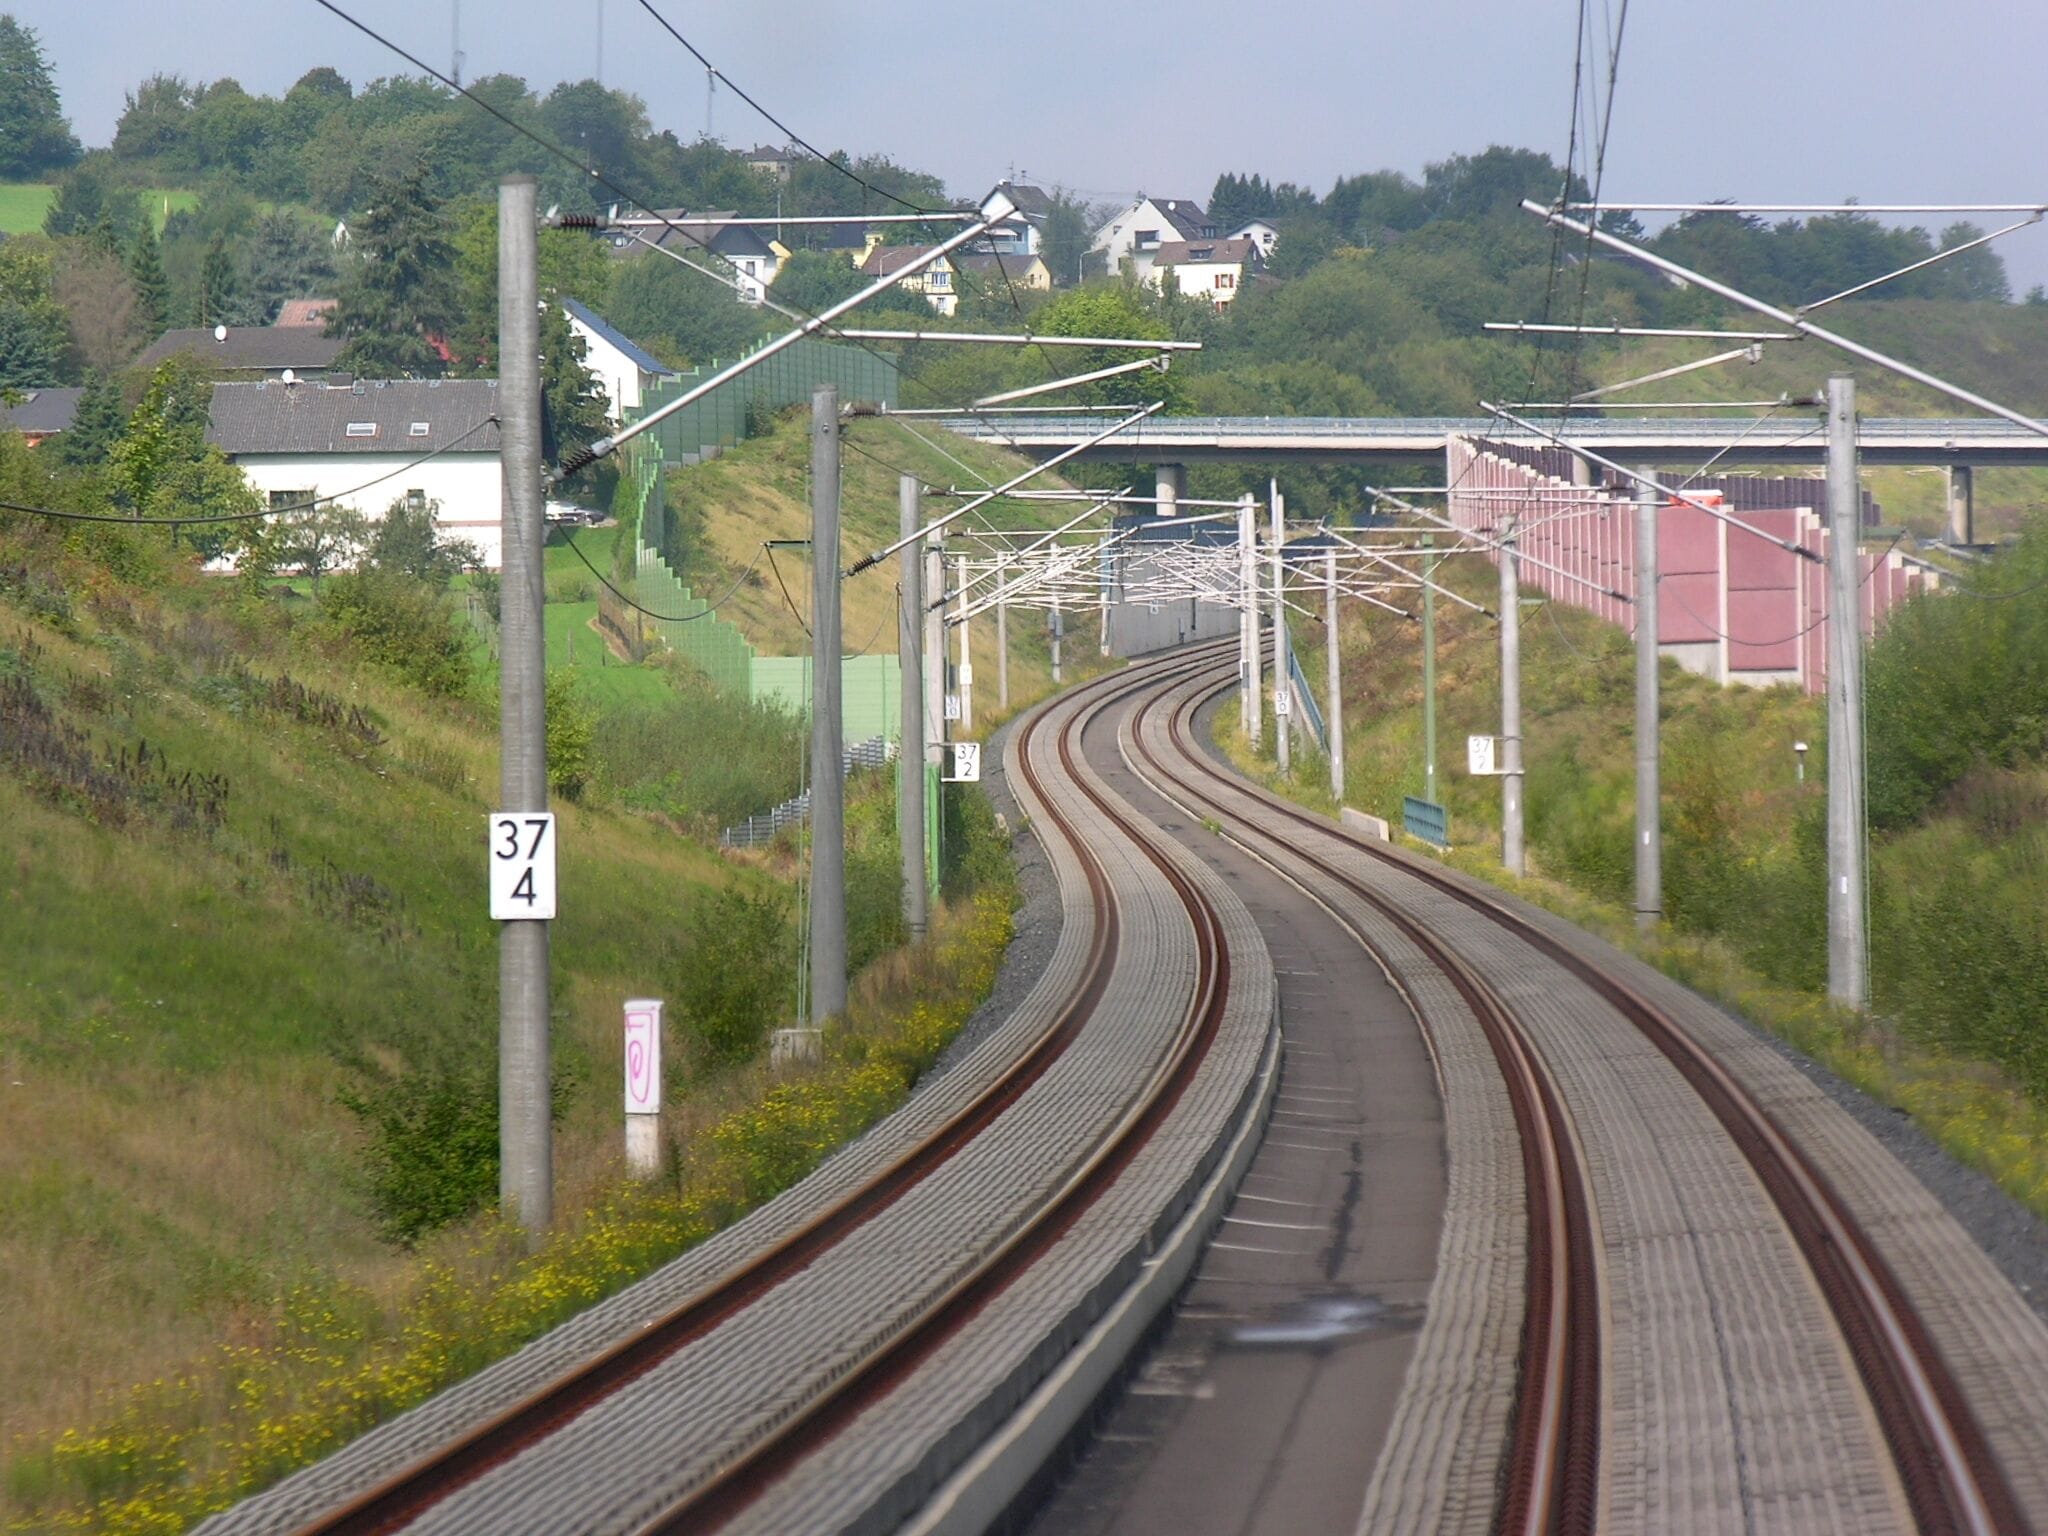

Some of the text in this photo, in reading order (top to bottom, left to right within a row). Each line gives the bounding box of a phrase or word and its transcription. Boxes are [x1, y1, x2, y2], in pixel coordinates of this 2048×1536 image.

[958, 745, 977, 760] 37
[1472, 738, 1490, 753] 37
[963, 762, 972, 777] 2
[1478, 755, 1486, 770] 2
[495, 819, 550, 860] 37
[510, 866, 537, 907] 4
